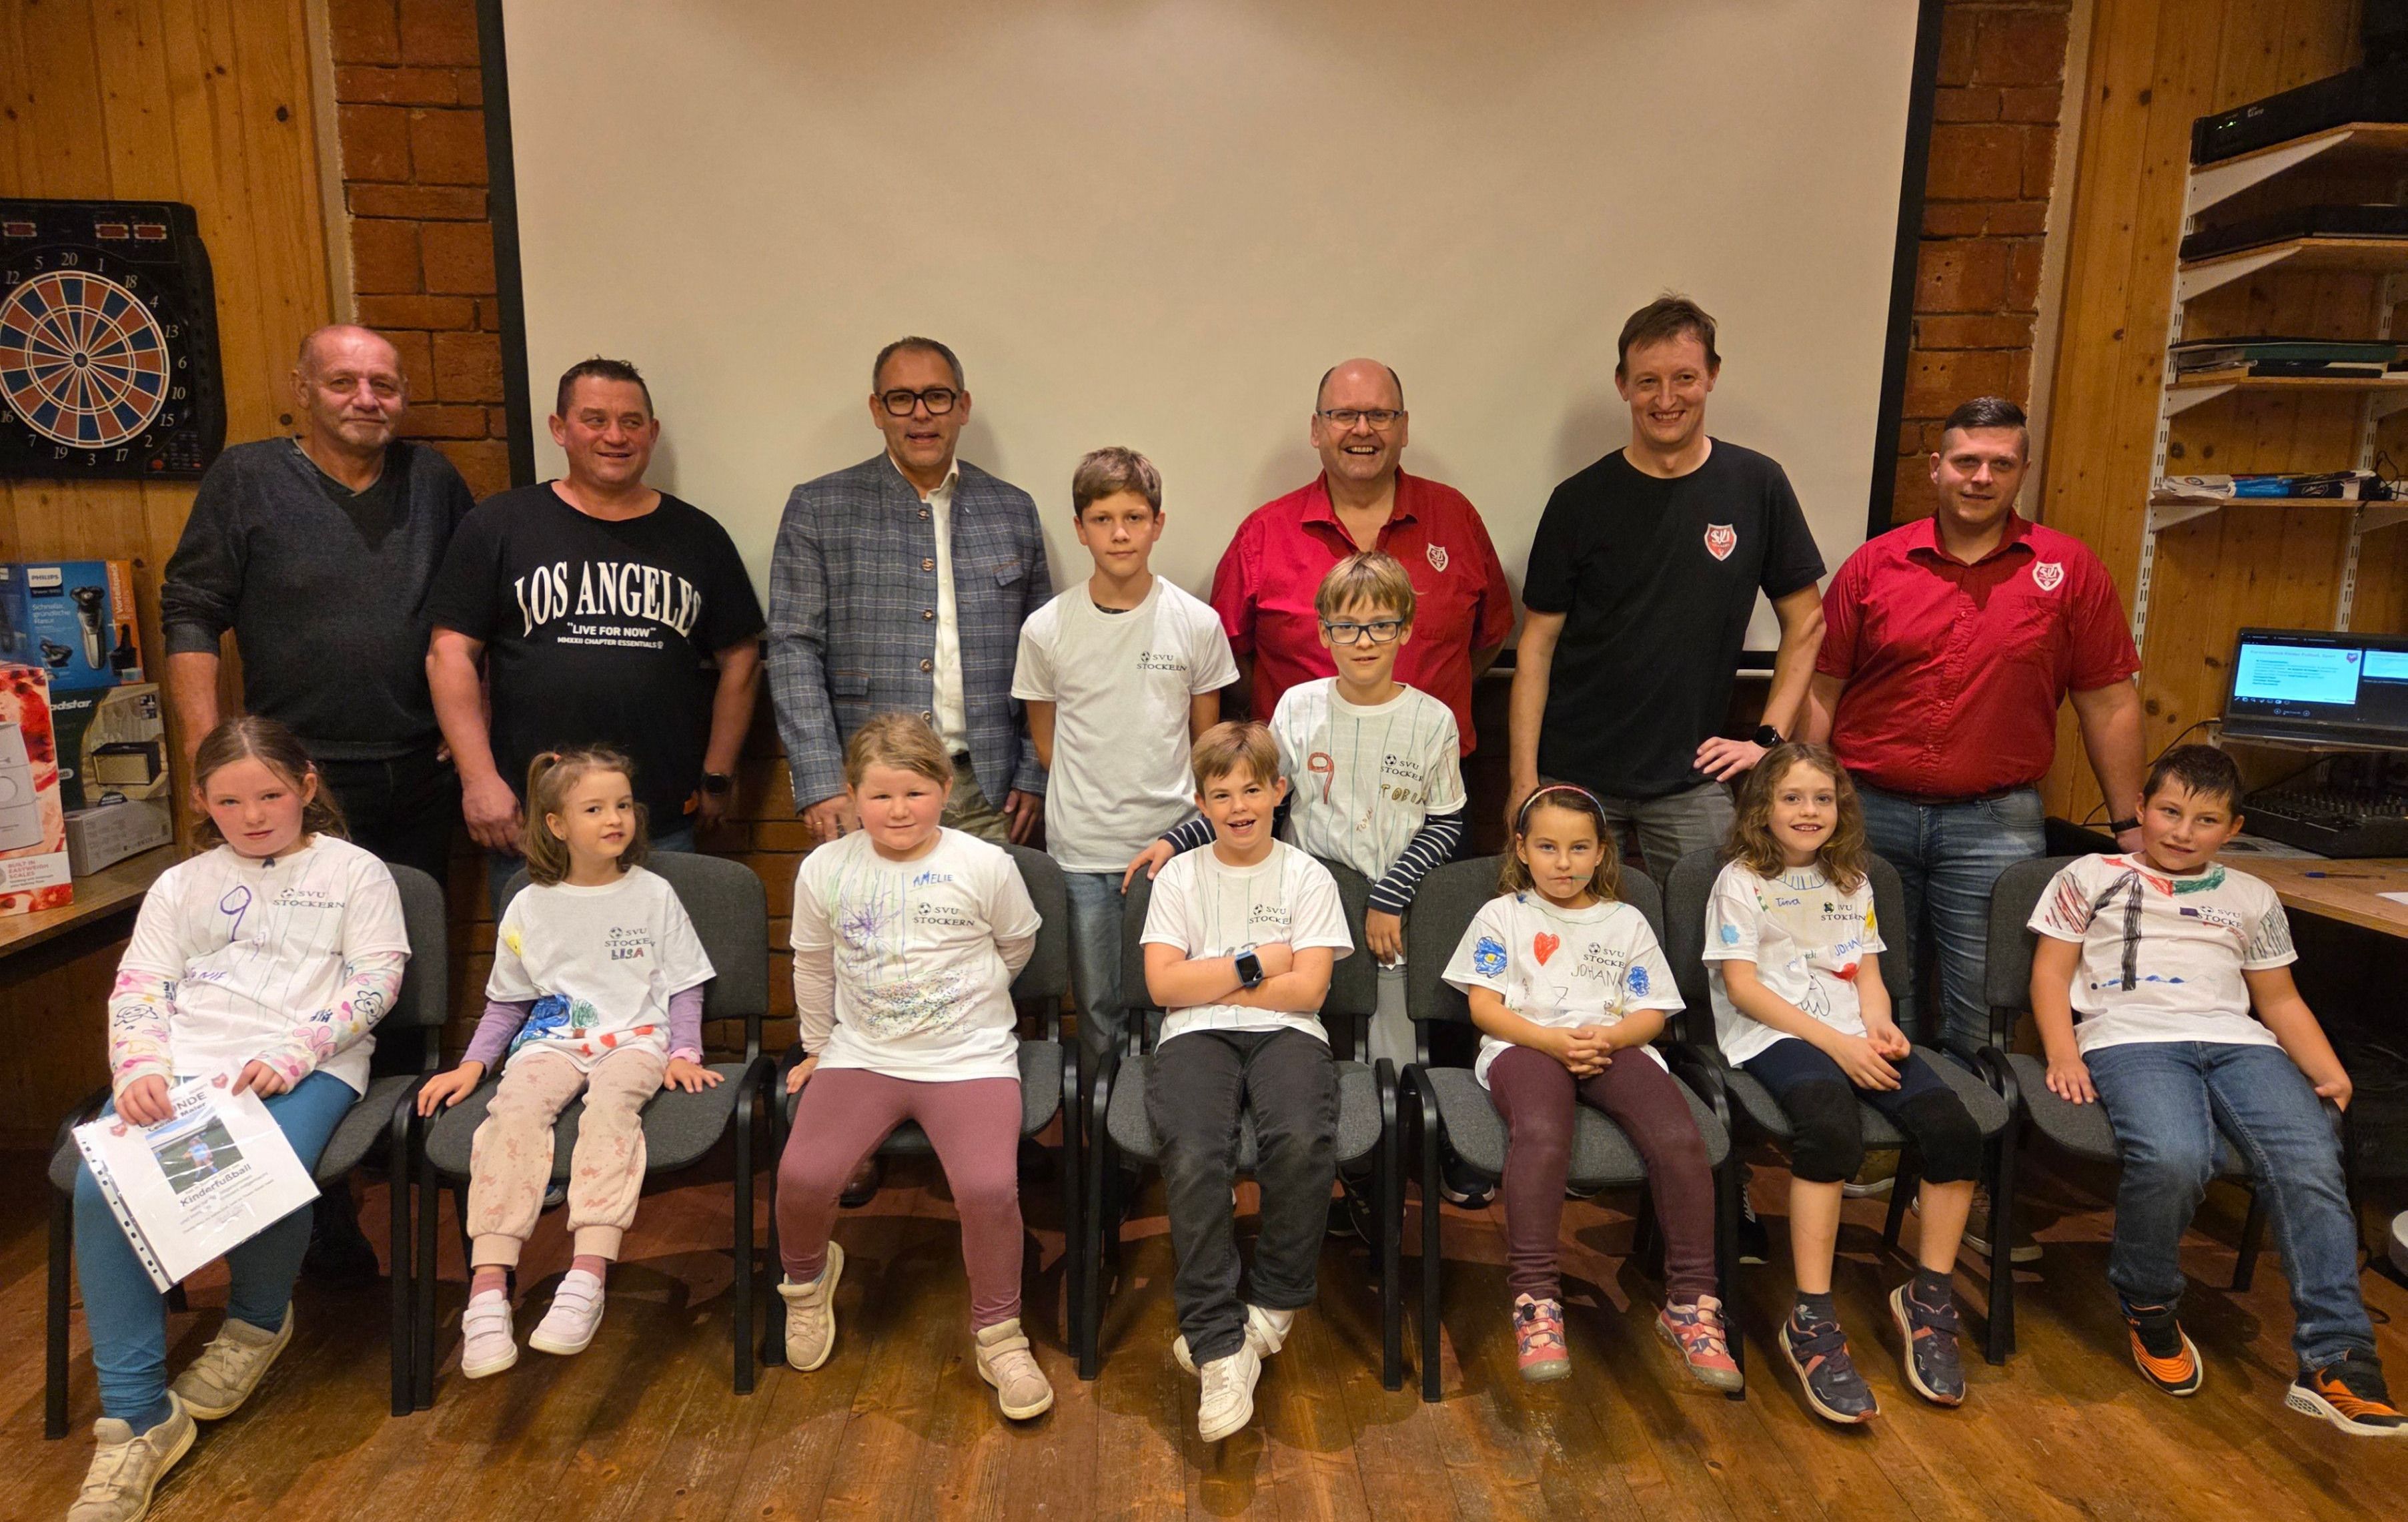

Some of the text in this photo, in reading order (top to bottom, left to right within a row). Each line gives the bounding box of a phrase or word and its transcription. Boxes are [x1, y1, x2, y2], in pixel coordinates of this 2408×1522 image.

[35, 256, 43, 268] 5
[61, 253, 78, 266] 20
[98, 258, 104, 272] 1
[6, 271, 20, 284] 12
[125, 275, 137, 288] 18
[149, 296, 159, 308] 4
[165, 326, 179, 338] 13
[178, 357, 187, 368] 6
[173, 387, 186, 399] 10
[1, 411, 13, 423] 16
[160, 414, 174, 426] 15
[29, 435, 37, 447] 7
[145, 435, 153, 448] 2
[55, 446, 68, 458] 19
[115, 449, 129, 462] 17
[88, 454, 95, 465] 3
[514, 561, 568, 637] LOS
[599, 625, 621, 637] FOR
[584, 637, 616, 646] CHAPTER
[48, 700, 92, 711] adstar
[1399, 761, 1419, 770] SVU
[1307, 752, 1334, 805] 9
[913, 870, 954, 887] AMELIE
[273, 899, 346, 908] STOCKERN
[1776, 897, 1800, 907] Tina
[220, 885, 251, 942] 9
[935, 907, 959, 915] SVU
[1266, 906, 1286, 914] SVU
[2217, 909, 2240, 918] SVU
[913, 917, 975, 926] STOCKERN
[626, 927, 647, 935] SVU
[611, 947, 644, 960] LISA
[1603, 948, 1624, 958] SVU
[1553, 986, 1568, 1007] 7
[180, 1164, 251, 1206] Kinderfußball
